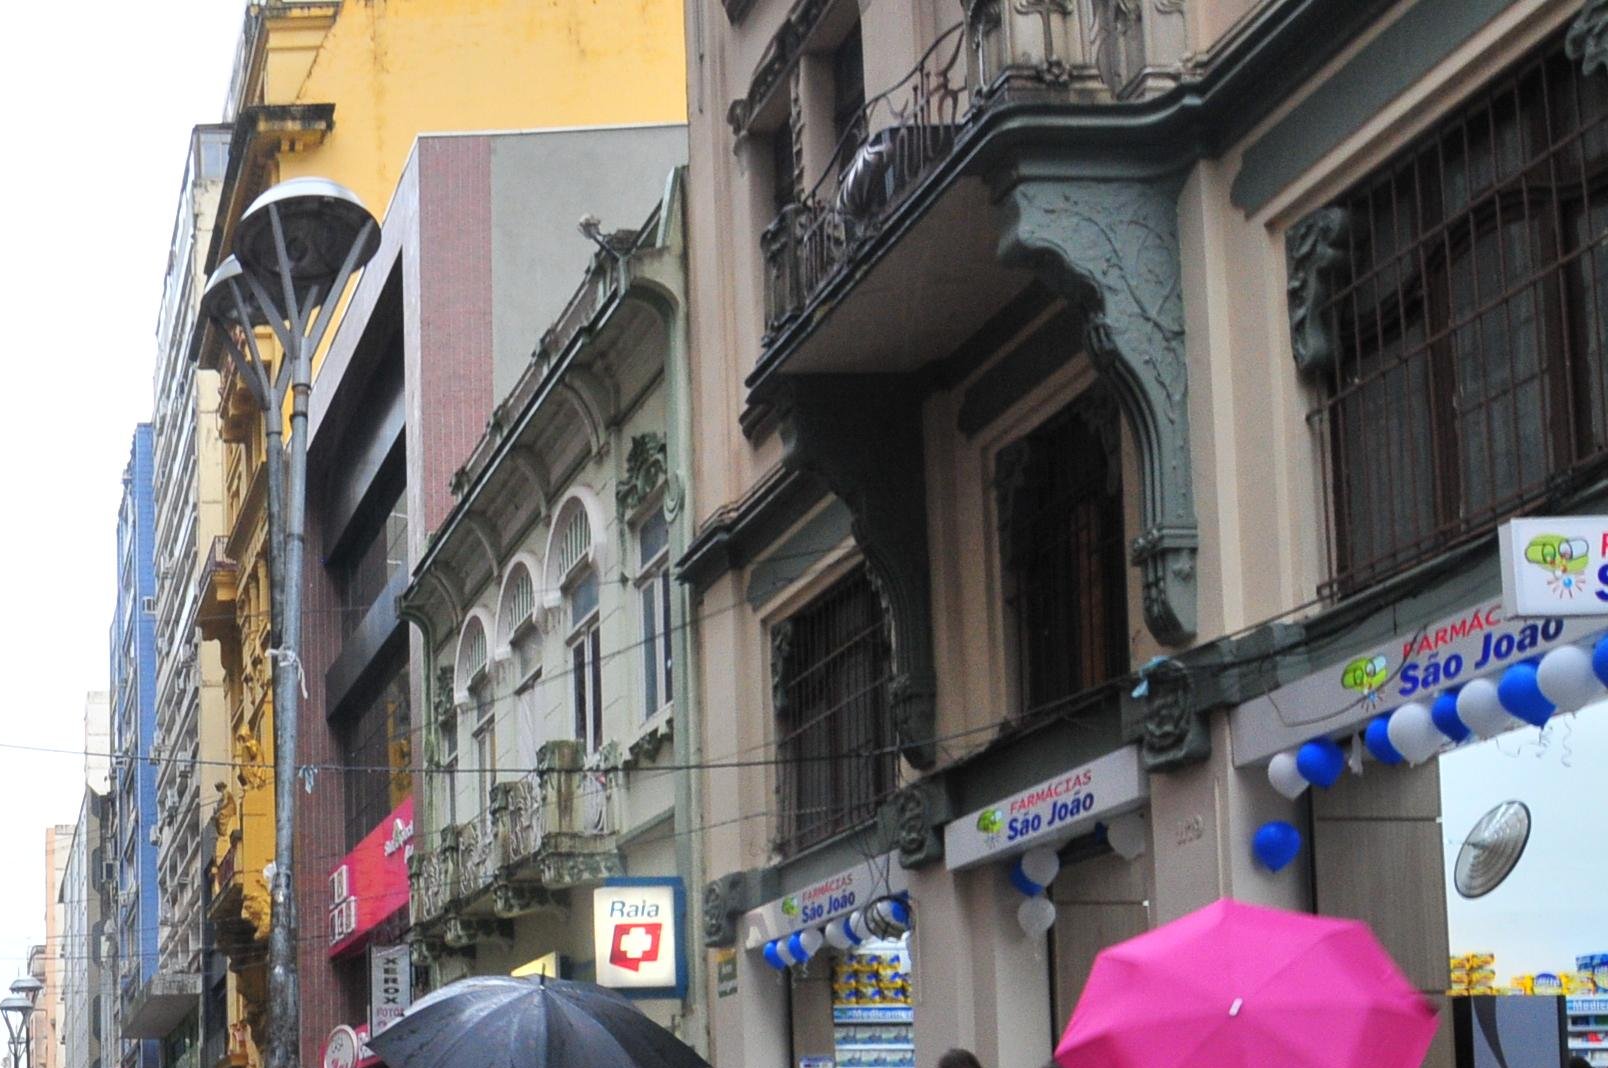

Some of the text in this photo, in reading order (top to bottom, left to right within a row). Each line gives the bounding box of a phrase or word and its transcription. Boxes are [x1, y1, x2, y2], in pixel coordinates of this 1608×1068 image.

[1402, 603, 1502, 657] FARMÁC
[1398, 652, 1463, 697] São
[1009, 769, 1093, 814] FARMÁCIAS
[1007, 788, 1094, 841] São João
[609, 899, 660, 918] Raia
[801, 873, 853, 903] FARMÁCIAS
[801, 888, 856, 923] São João
[383, 957, 400, 1004] XEROX
